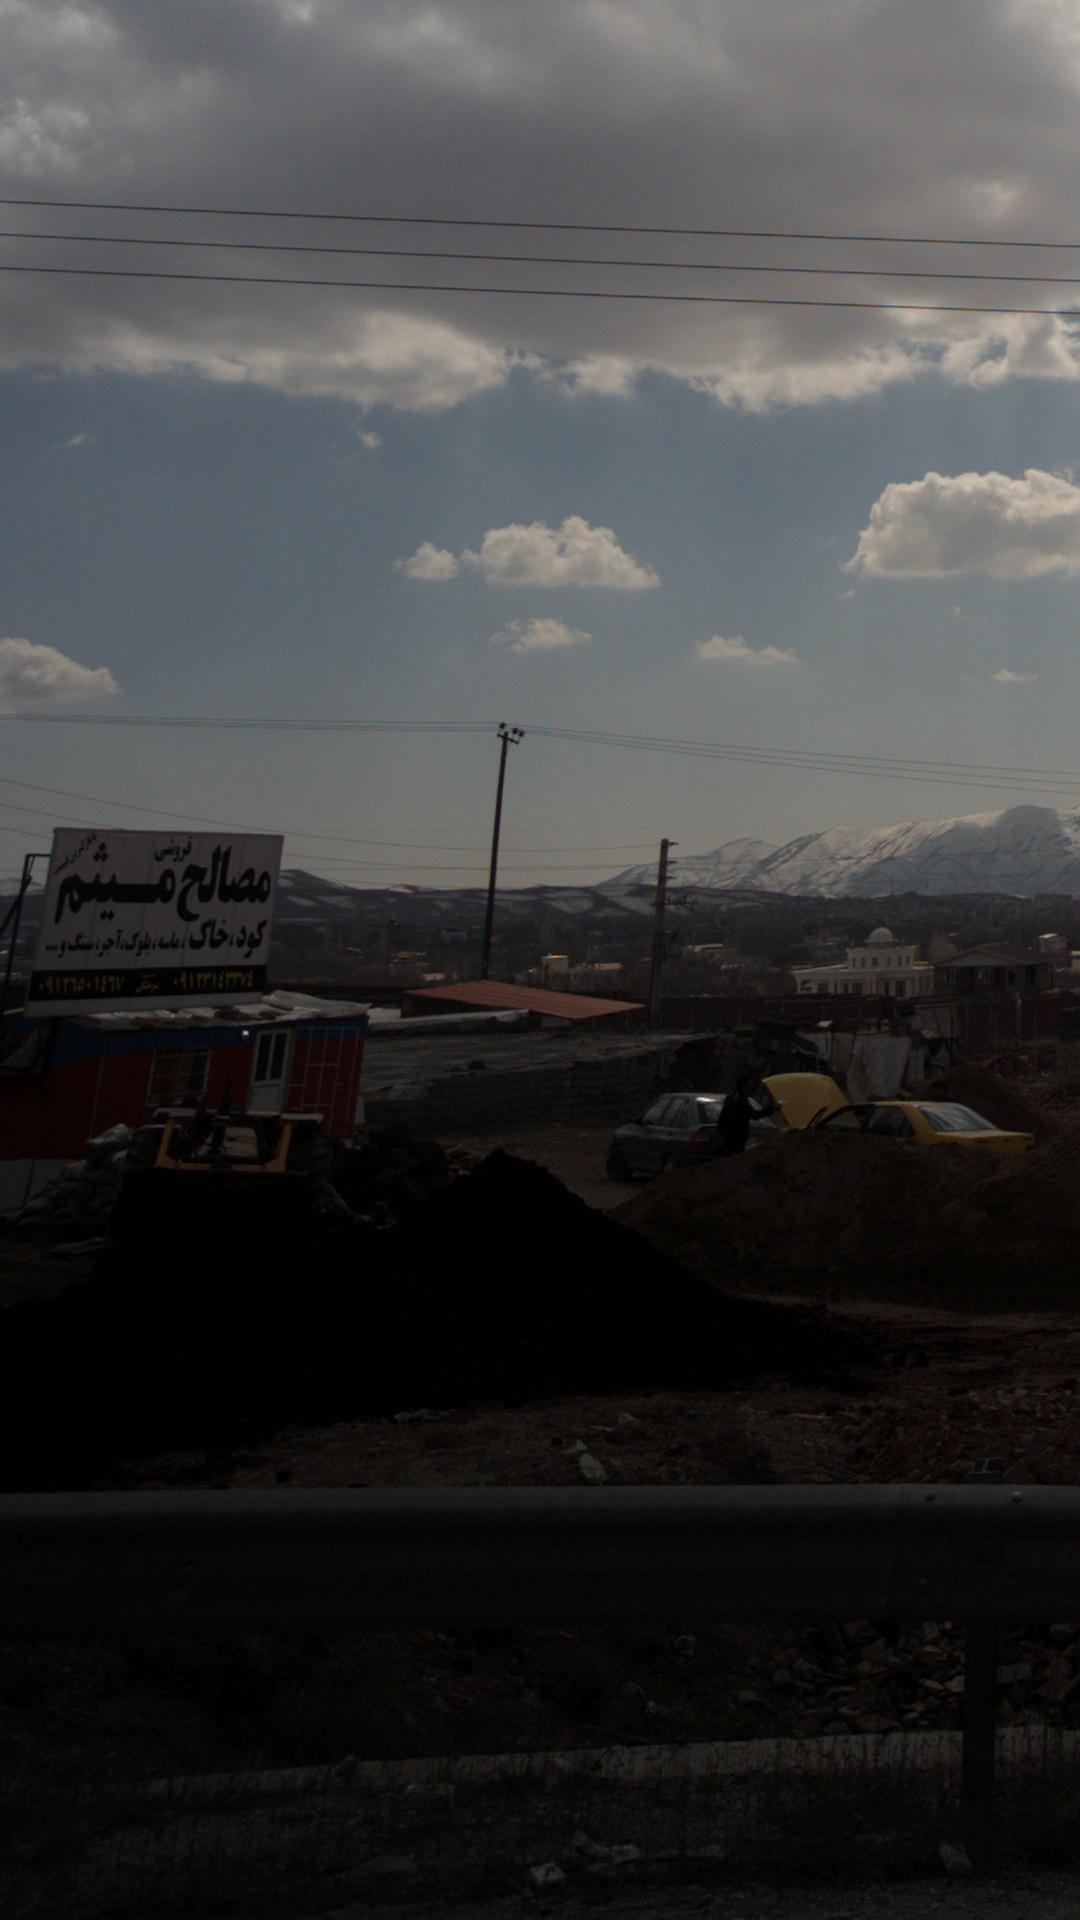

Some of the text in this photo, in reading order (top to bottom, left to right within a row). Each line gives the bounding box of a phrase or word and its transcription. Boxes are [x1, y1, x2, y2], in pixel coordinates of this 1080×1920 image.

[55, 842, 176, 924] میثم
[154, 835, 192, 862] فروشی
[177, 845, 271, 921] مصالح
